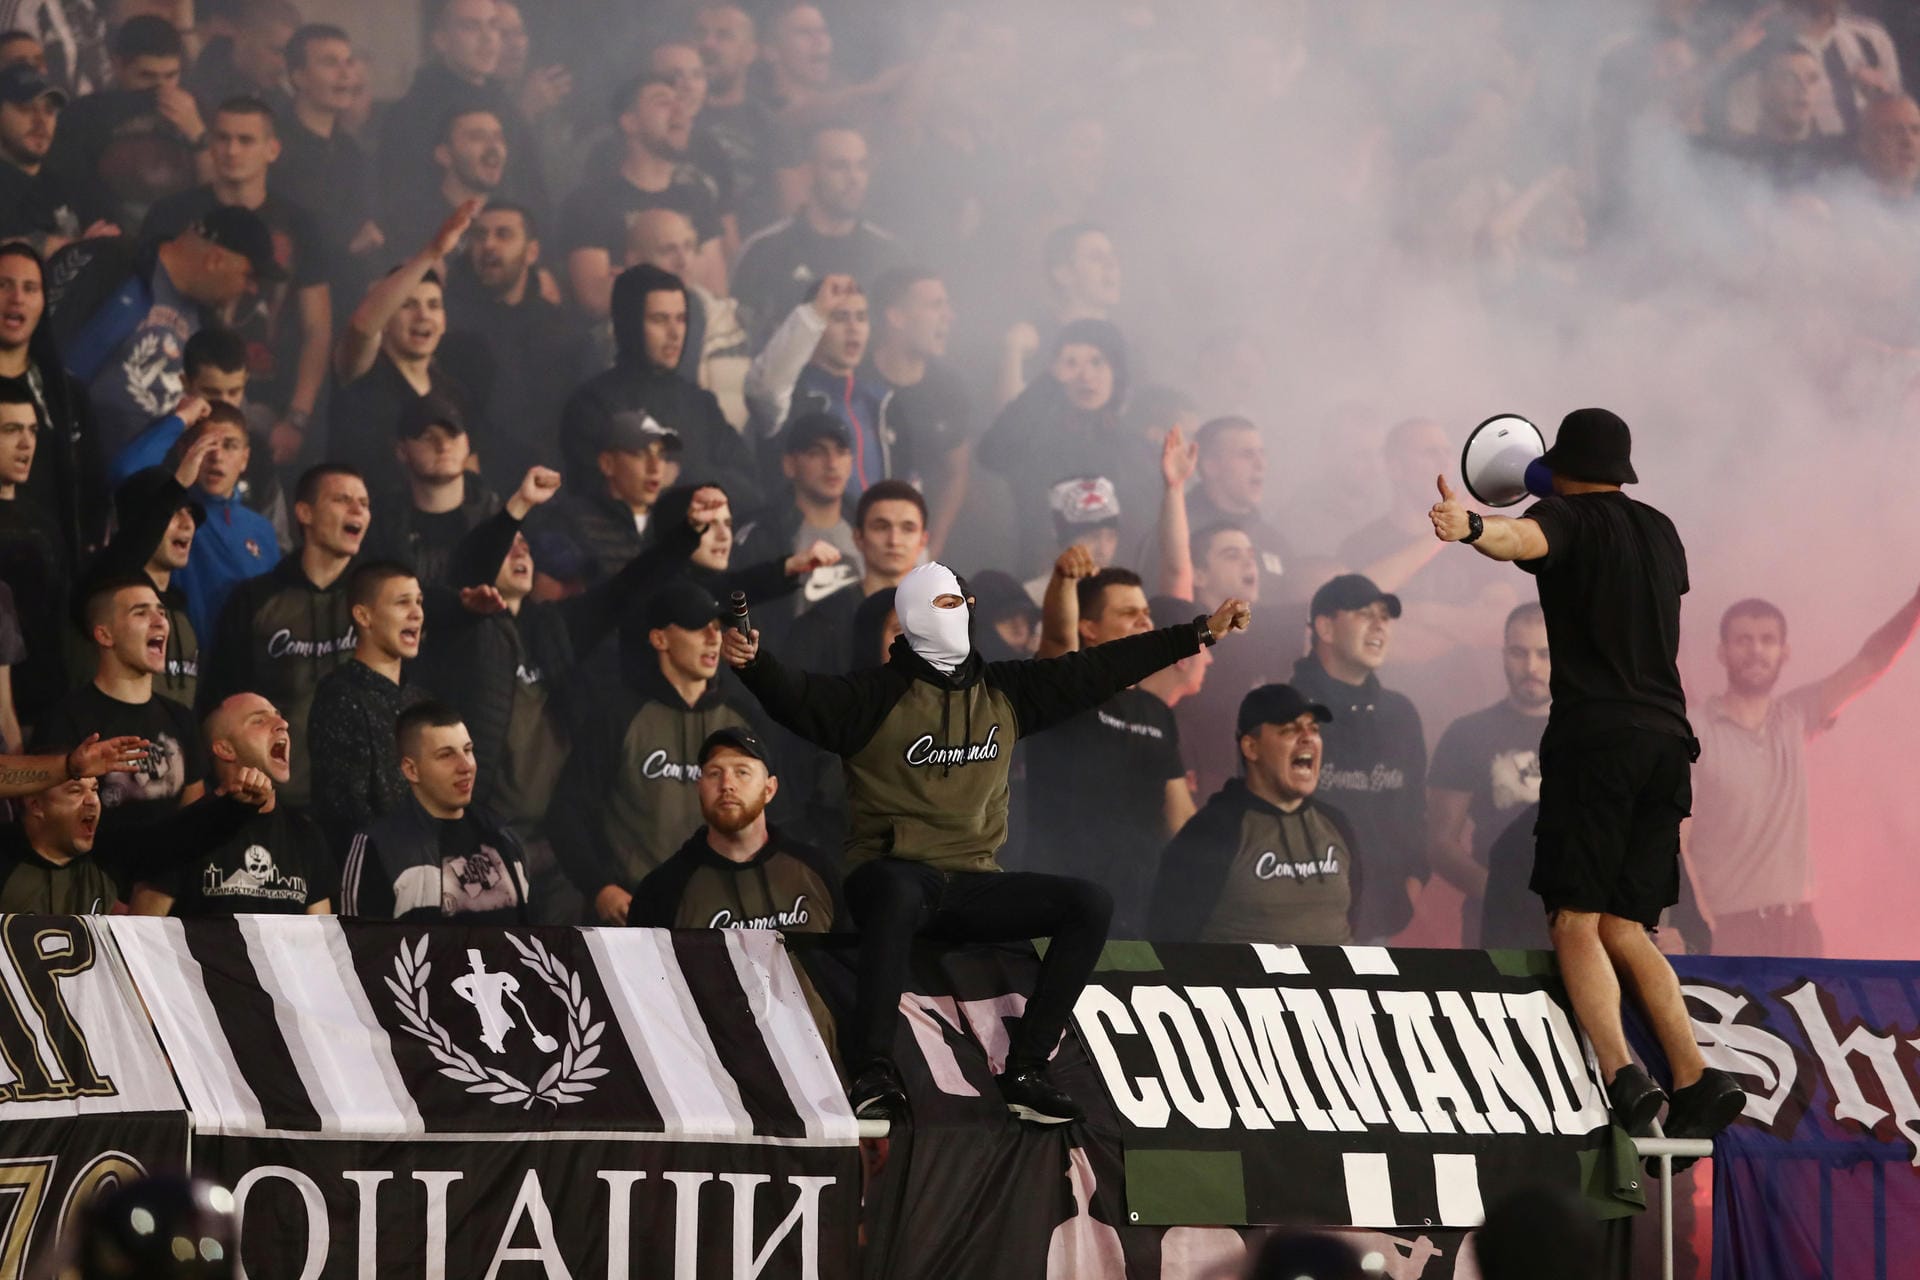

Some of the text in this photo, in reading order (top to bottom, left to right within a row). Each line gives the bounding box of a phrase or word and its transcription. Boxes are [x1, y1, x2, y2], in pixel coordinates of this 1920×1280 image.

[643, 750, 702, 781] Comm
[1072, 984, 1613, 1135] COMMAND
[1680, 981, 1920, 1167] Sh
